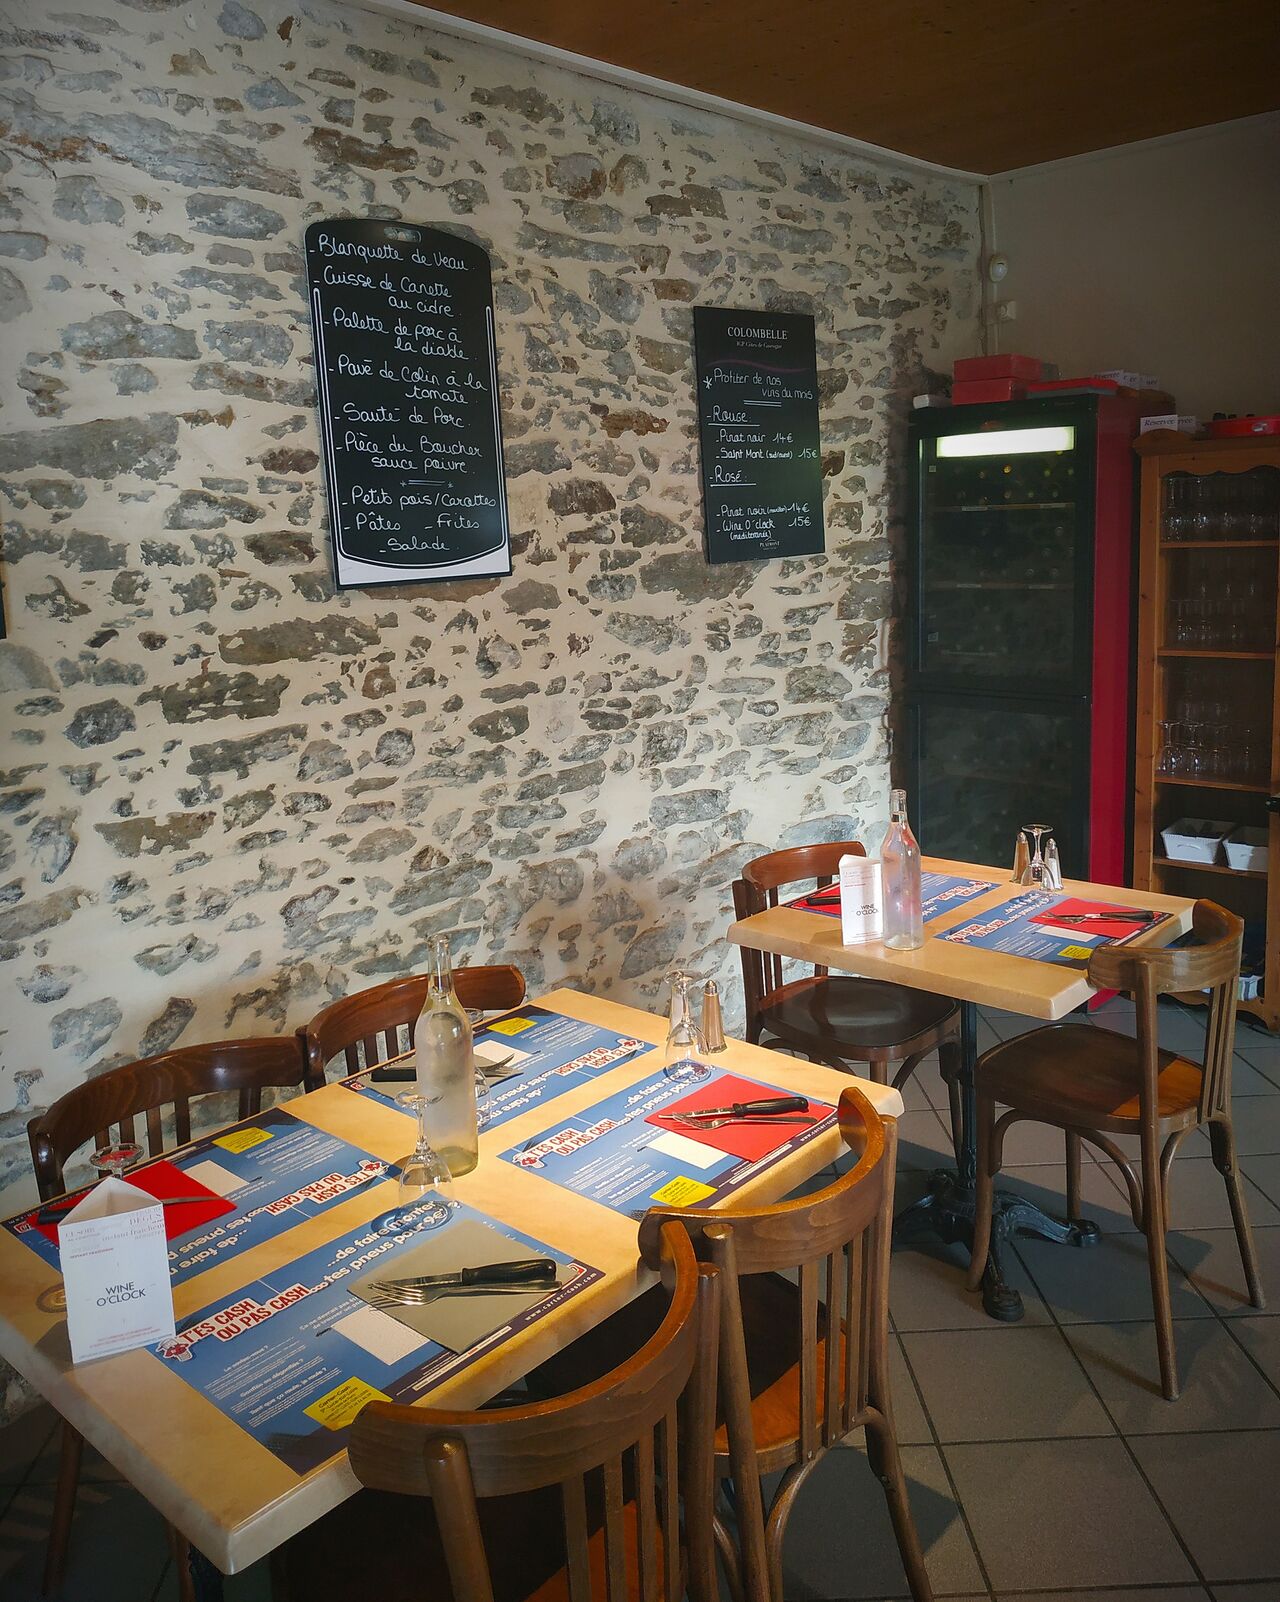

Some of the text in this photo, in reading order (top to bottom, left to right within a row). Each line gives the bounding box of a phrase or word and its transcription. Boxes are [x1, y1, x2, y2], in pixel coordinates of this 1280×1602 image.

[318, 233, 469, 271] Blanquette de Veau
[323, 265, 452, 297] Cuisse de Canette
[388, 296, 454, 317] au cidre
[333, 306, 390, 334] Palette
[394, 318, 414, 335] de
[727, 326, 788, 340] COLOMBELLE
[394, 336, 470, 360] la diable
[379, 361, 400, 381] de
[401, 366, 441, 385] Colin
[464, 372, 488, 391] la
[752, 372, 763, 385] de
[766, 375, 782, 386] nos
[405, 385, 469, 404] tomate
[761, 388, 780, 398] vins
[781, 387, 793, 398] du
[408, 406, 428, 424] de
[720, 428, 746, 443] Pinot
[747, 432, 766, 443] noir
[389, 434, 413, 453] du
[420, 436, 483, 458] Boucher
[720, 447, 743, 460] Saint
[745, 448, 765, 459] Mont
[371, 456, 468, 474] sauce poivre
[714, 464, 742, 483] Rosé
[351, 485, 393, 505] Petits
[721, 504, 745, 517] Pinot
[747, 506, 767, 516] noir
[437, 513, 480, 529] Frites
[722, 519, 743, 532] Wine
[387, 535, 450, 551] Salade
[552, 1129, 580, 1150] CASH
[556, 1144, 574, 1156] OU
[575, 1131, 594, 1148] PAS
[592, 1119, 618, 1137] CASH
[298, 1180, 322, 1197] PAS
[323, 1173, 344, 1186] OU
[313, 1183, 346, 1203] CASH
[265, 1193, 301, 1214] CASH
[354, 1227, 390, 1248] faire
[388, 1200, 436, 1231] monter
[179, 1226, 226, 1254] pneus
[178, 1244, 218, 1269] faire
[105, 1281, 135, 1295] WINE
[216, 1322, 242, 1341] OU
[243, 1307, 272, 1328] PAS
[269, 1285, 310, 1311] CASH
[350, 1240, 395, 1271] pneus
[392, 1223, 425, 1245] pour
[96, 1288, 147, 1307] O'CLOCK
[525, 1272, 597, 1322] www.carter-cash.com
[179, 1322, 216, 1344] T'ES
[214, 1300, 256, 1325] CASH
